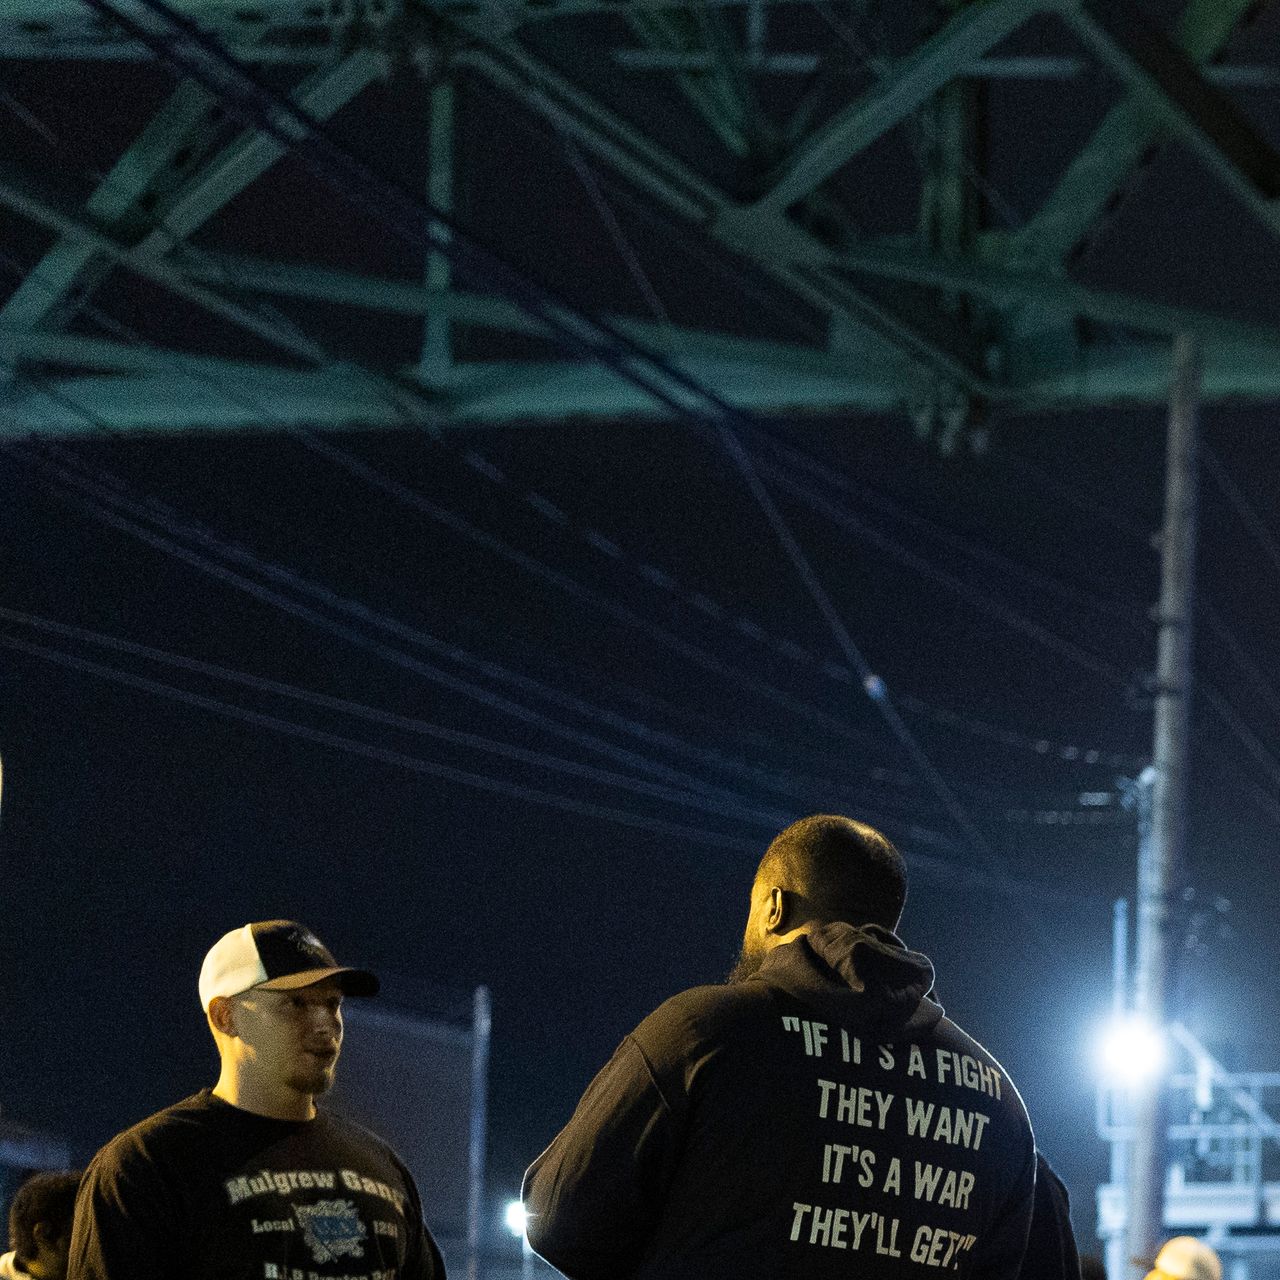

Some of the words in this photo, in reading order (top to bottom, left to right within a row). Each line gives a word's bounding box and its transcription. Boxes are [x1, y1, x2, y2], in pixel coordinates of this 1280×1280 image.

[782, 1016, 828, 1057] "IF
[906, 1043, 927, 1080] A
[936, 1048, 1001, 1100] FIGHT
[817, 1078, 894, 1130] THEY
[905, 1097, 990, 1150] WANT
[226, 1170, 336, 1206] Mulgrew
[821, 1144, 876, 1188] IT'S
[882, 1157, 901, 1196] A
[914, 1160, 976, 1210] WAR
[789, 1201, 901, 1258] THEY'LL
